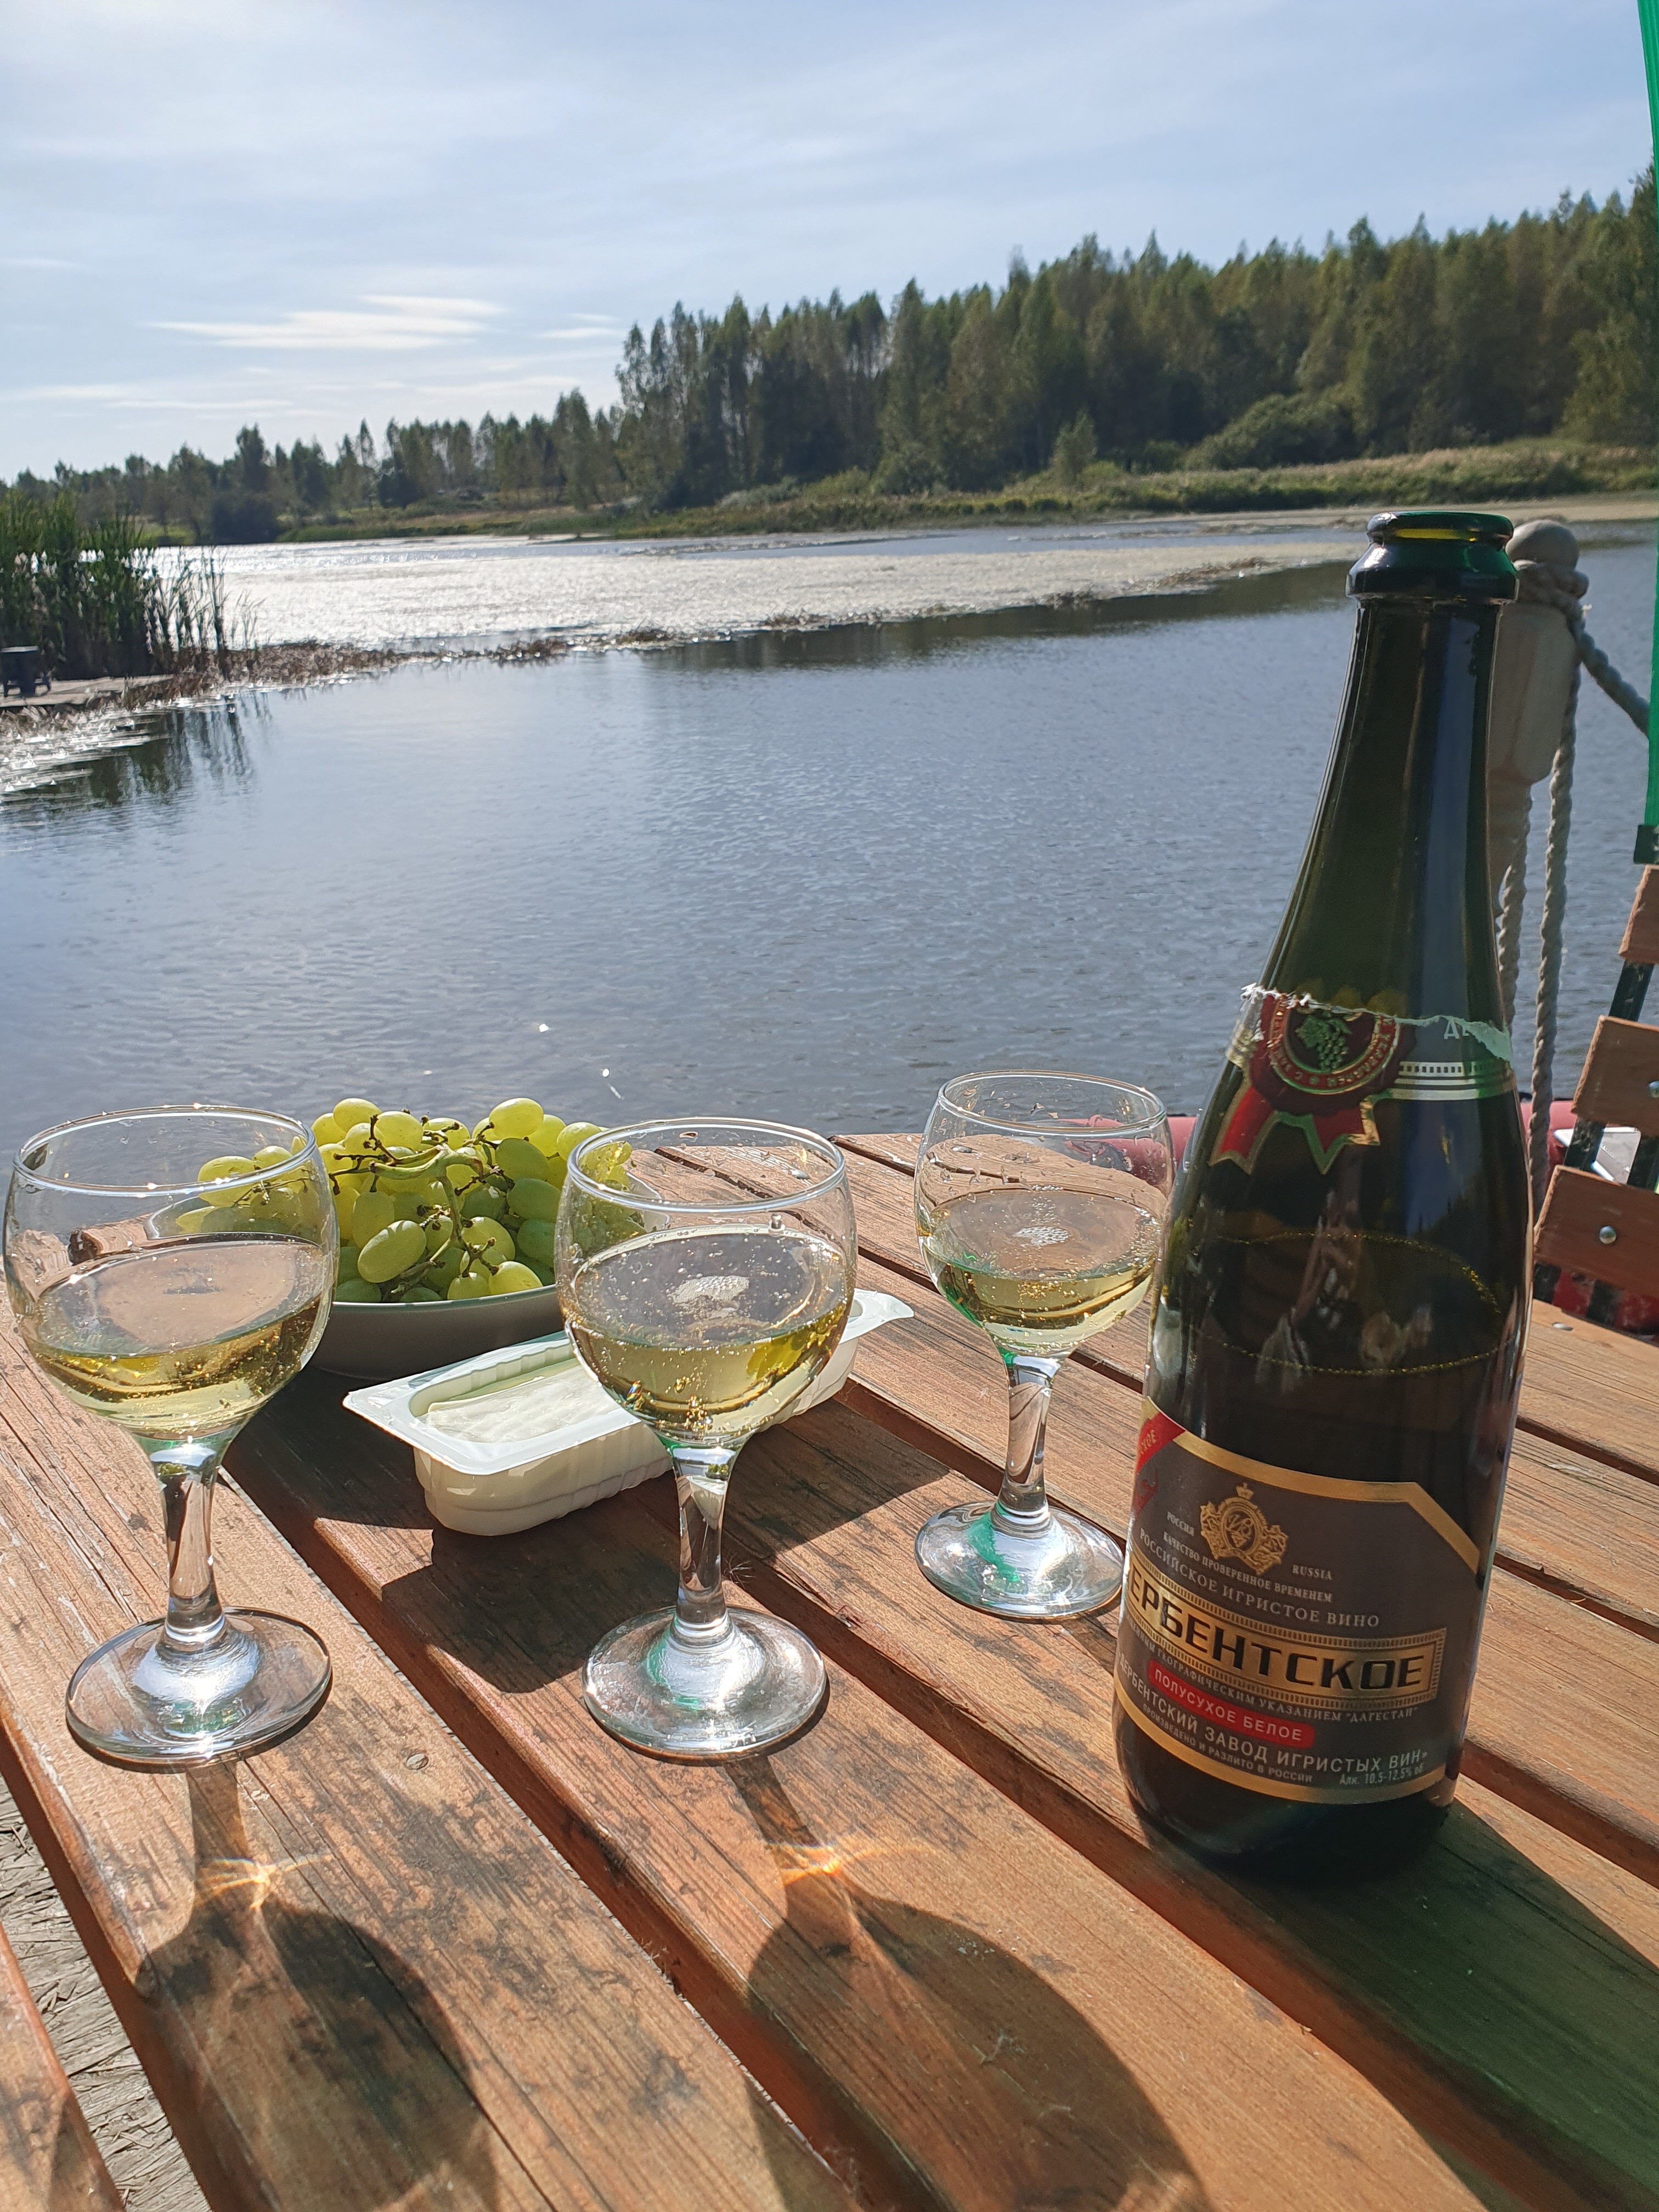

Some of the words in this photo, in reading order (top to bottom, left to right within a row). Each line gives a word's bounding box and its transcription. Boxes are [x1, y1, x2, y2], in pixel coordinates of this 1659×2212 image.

[1167, 1511, 1194, 1536] РОССИЯ
[1140, 1527, 1217, 1592] РОССИЙСКОЕ
[1223, 1585, 1319, 1622] ИГРИСТОЕ
[1328, 1612, 1379, 1627] ВИНО
[1163, 1531, 1200, 1561] КАЧЕСТВО
[1203, 1556, 1271, 1589] ПРОВЕРЕННОЕ
[1274, 1582, 1333, 1602] ВРЕМЕНЕМ
[1292, 1565, 1332, 1580] RUSSIA
[1130, 1562, 1424, 1690] ЕРБЕНТСКОЕ
[1155, 1668, 1236, 1723] ПОЛУСУХОЕ
[1243, 1716, 1302, 1741] БЕЛОЕ
[1158, 1648, 1255, 1705] ГЕОГРАФИЧЕСКИМ
[1260, 1699, 1341, 1721] УКАЗАНИЕМ
[1143, 1703, 1196, 1745] ПРОИЗВЕДЕНО
[1199, 1742, 1205, 1751] И
[1209, 1746, 1253, 1770] РАЗЛИТО
[1269, 1768, 1312, 1782] РОССИИ
[1205, 1726, 1267, 1764] ЗАВОД
[1277, 1750, 1381, 1773] ИГРИСТЫХ
